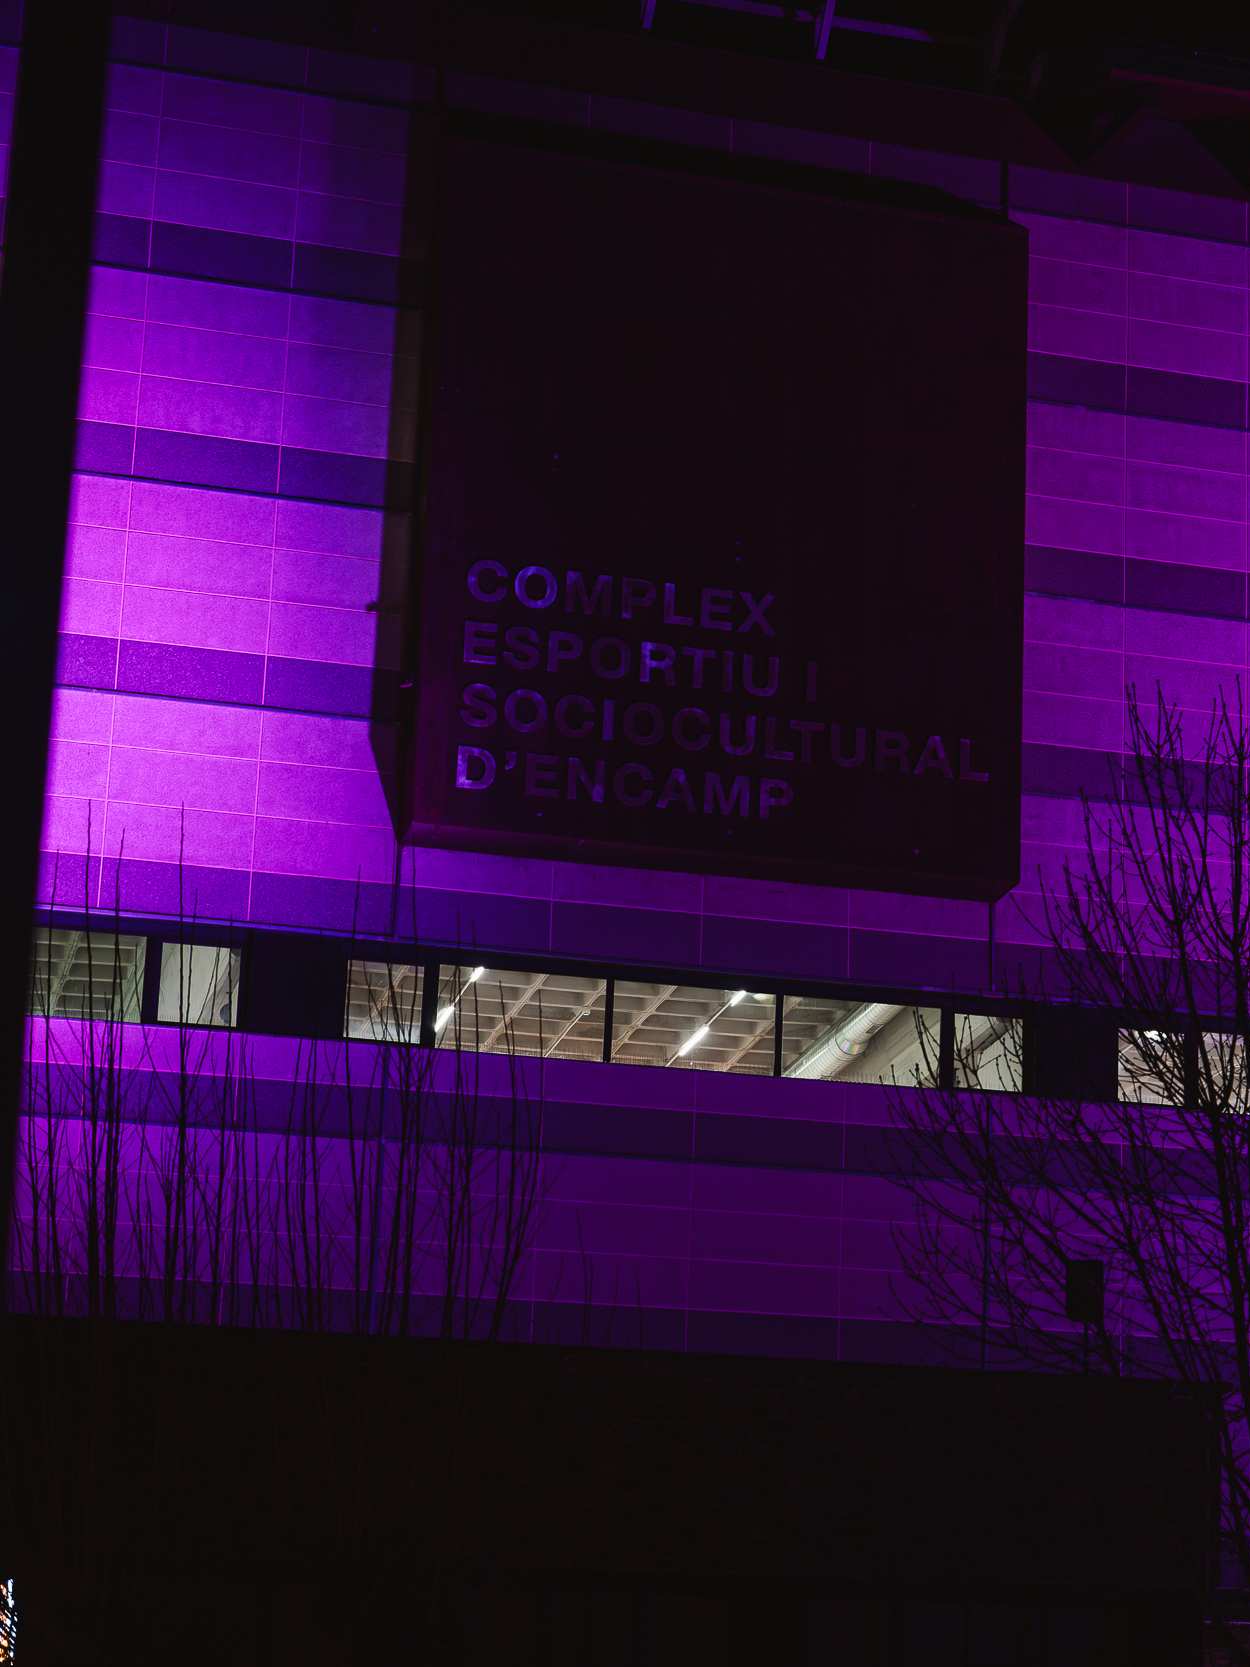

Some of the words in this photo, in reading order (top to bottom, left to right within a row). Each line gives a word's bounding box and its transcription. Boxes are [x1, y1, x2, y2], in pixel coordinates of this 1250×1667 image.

[467, 559, 776, 636] COMPLEX
[463, 620, 780, 697] ESPORTIU
[806, 661, 818, 702] I
[460, 682, 990, 782] SOCIOCULTURAL
[455, 744, 795, 819] D'ENCAMP
